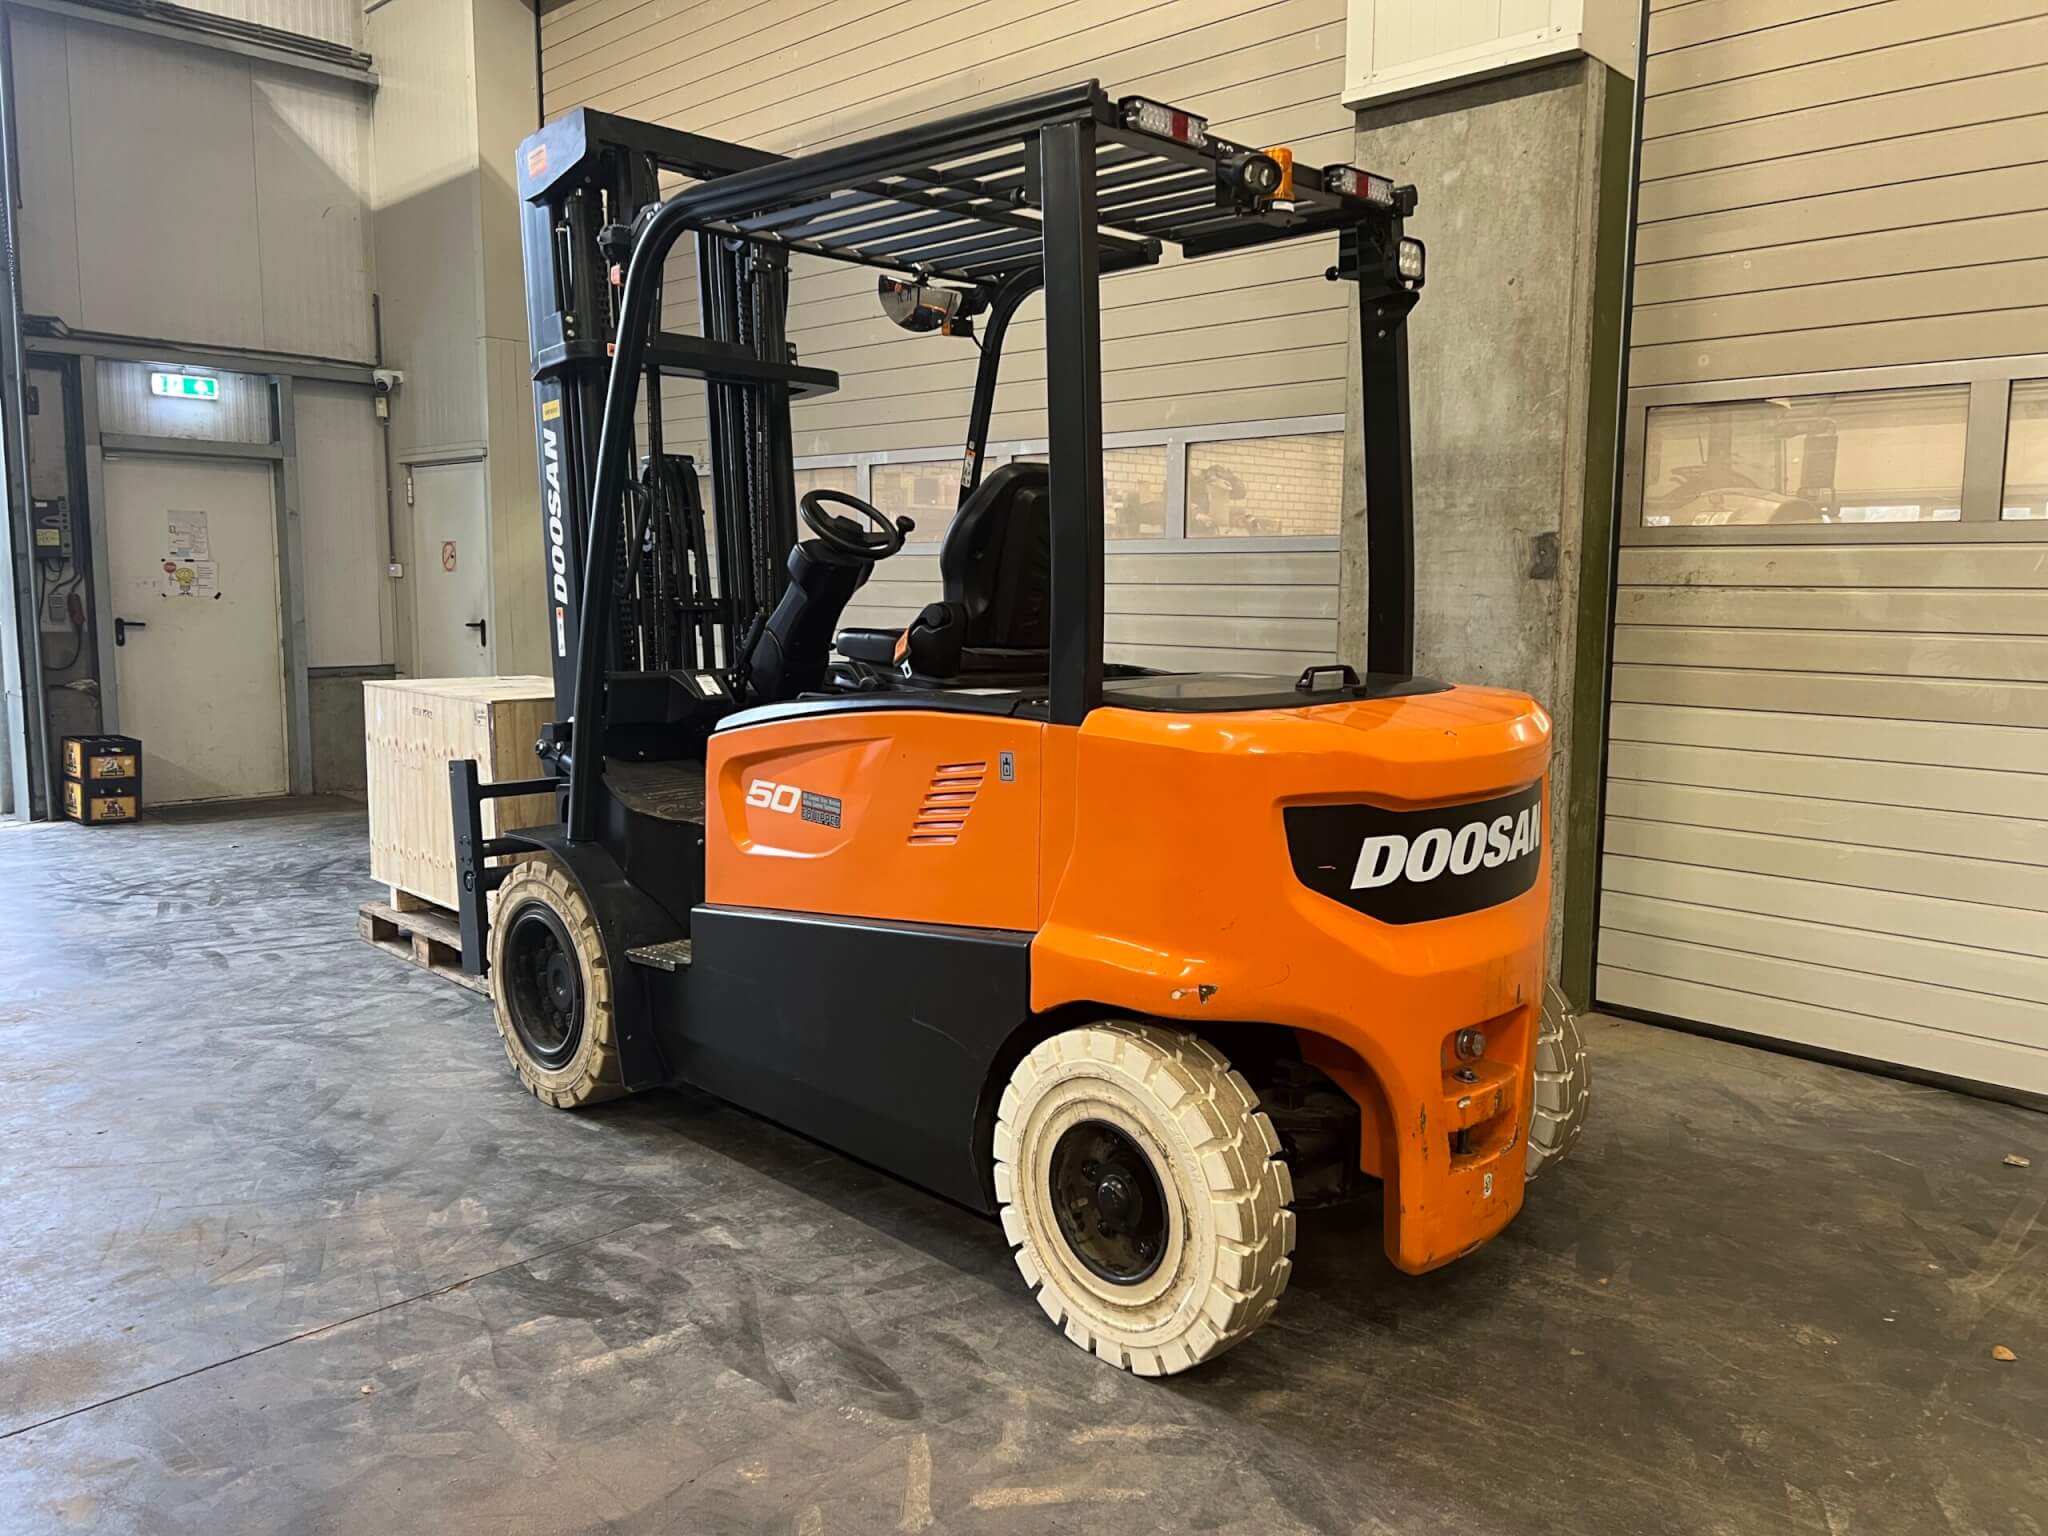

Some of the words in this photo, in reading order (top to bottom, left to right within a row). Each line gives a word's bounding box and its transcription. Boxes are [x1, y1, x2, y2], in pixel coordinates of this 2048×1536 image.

[543, 427, 569, 606] DOOSAN
[745, 778, 802, 814] 50
[1350, 800, 1542, 890] DOOSAN
